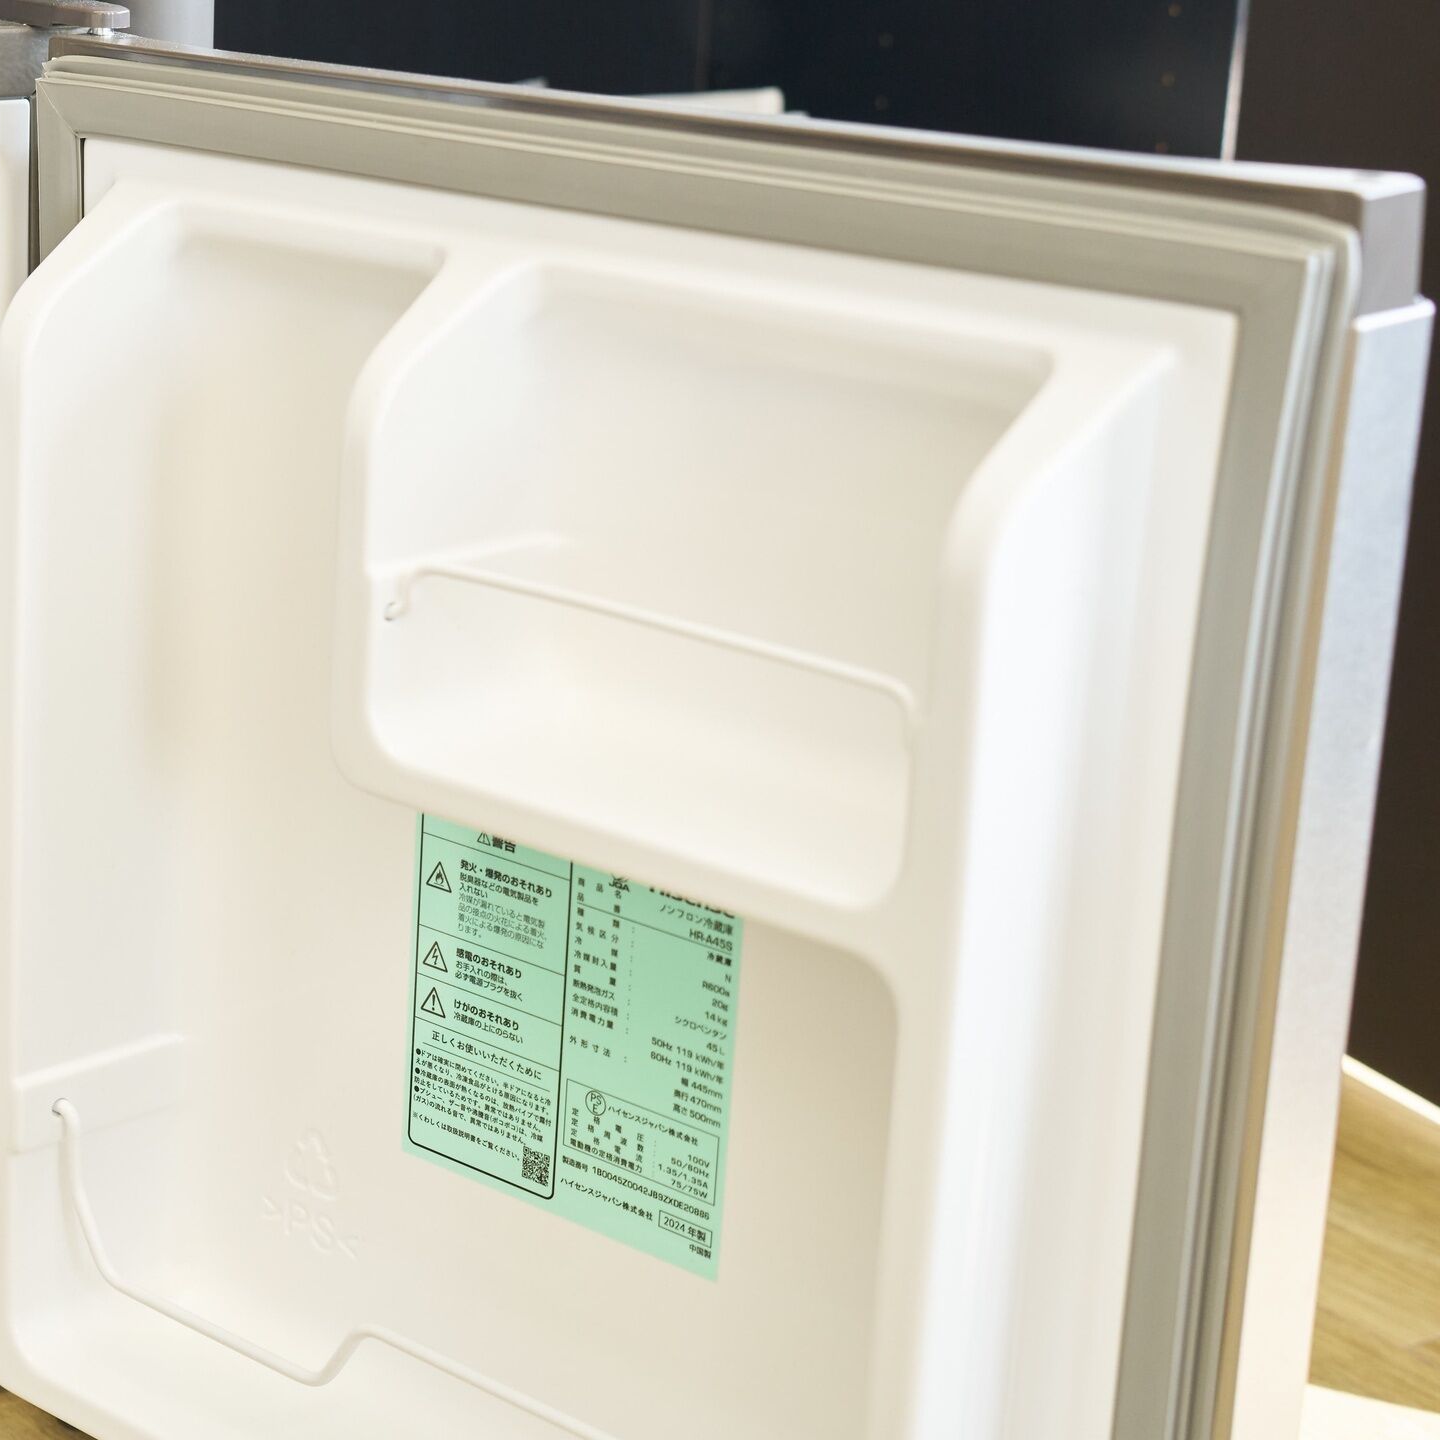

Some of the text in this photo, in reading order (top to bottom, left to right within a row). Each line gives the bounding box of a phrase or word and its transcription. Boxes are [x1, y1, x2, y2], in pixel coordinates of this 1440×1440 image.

[460, 859, 552, 898] 発火・爆発のおそれあり
[460, 872, 538, 906] 脱臭器などの電気製品を
[460, 883, 488, 898] 入れない
[458, 924, 482, 938] ります。
[660, 904, 733, 935] ノンフロン冷蔵庫
[456, 948, 522, 978] 感電のおそれあり
[456, 960, 508, 986] お手入れの際は、
[455, 970, 522, 1002] 必ず電源プラグを抜く
[573, 979, 615, 1000] 断熱発泡ガス
[454, 999, 518, 1030] けがのおそれあり
[572, 993, 618, 1018] 全定格内容積
[454, 1011, 523, 1044] 冷蔵庫の上にのらない
[571, 1008, 614, 1030] 消費電力量
[675, 1016, 726, 1040] シクロペンタン
[432, 1030, 541, 1080] 正しくお使いいただくために
[570, 1035, 611, 1058] 外形寸法
[652, 1037, 672, 1051] 50Hz
[691, 1082, 722, 1100] 445mm
[608, 1106, 698, 1146] ハイセンスジャパン株式会社
[690, 1110, 720, 1128] 500mm
[562, 1155, 588, 1173] 製造番号
[570, 1138, 642, 1173] 電動機の定格消費電力
[671, 1158, 710, 1178] 50/60Hz
[688, 1154, 710, 1168] 100V
[658, 1164, 708, 1189] 1.35/1.35A
[672, 1179, 708, 1199] 75/75W
[560, 1178, 653, 1222] ハイセンスジャパン株式会社
[664, 1216, 706, 1242] 2024 年製
[690, 1244, 711, 1260] 中国製
